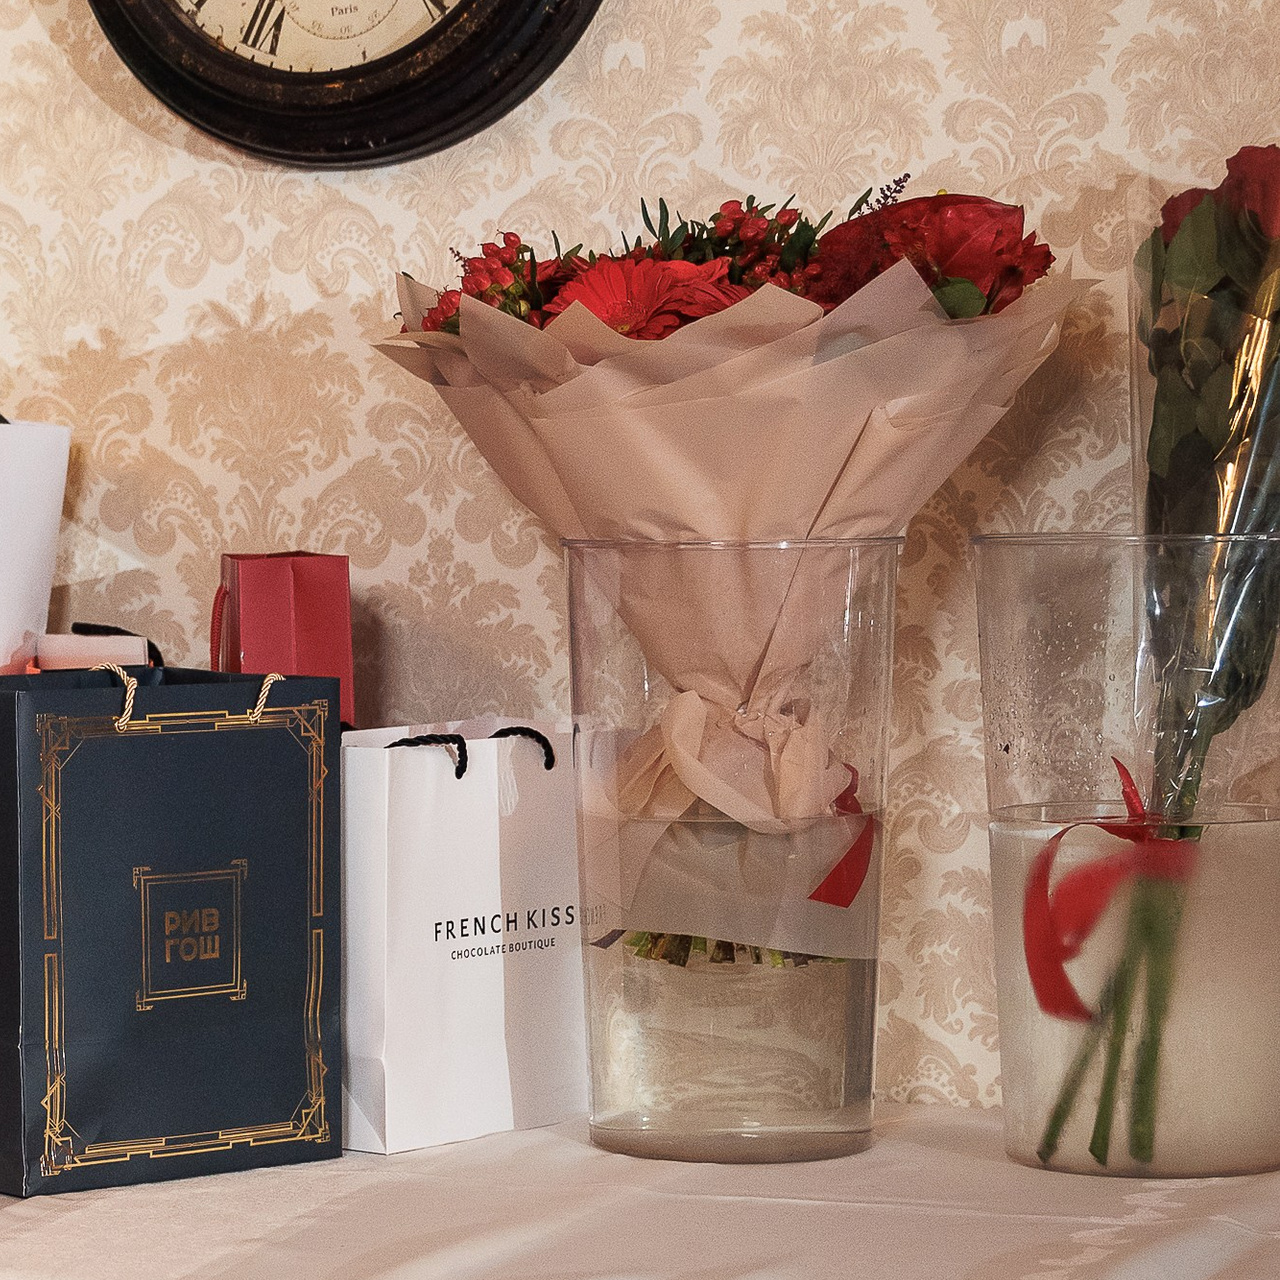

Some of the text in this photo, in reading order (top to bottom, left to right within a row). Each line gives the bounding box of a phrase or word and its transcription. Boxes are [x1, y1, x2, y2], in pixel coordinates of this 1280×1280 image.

[331, 4, 359, 16] Paris
[164, 907, 220, 936] РИВ
[434, 912, 518, 942] FRENCH
[526, 905, 576, 930] KISS
[164, 934, 220, 963] ГОШ
[451, 937, 556, 960] CHOCOLATE BOUTIQUE
